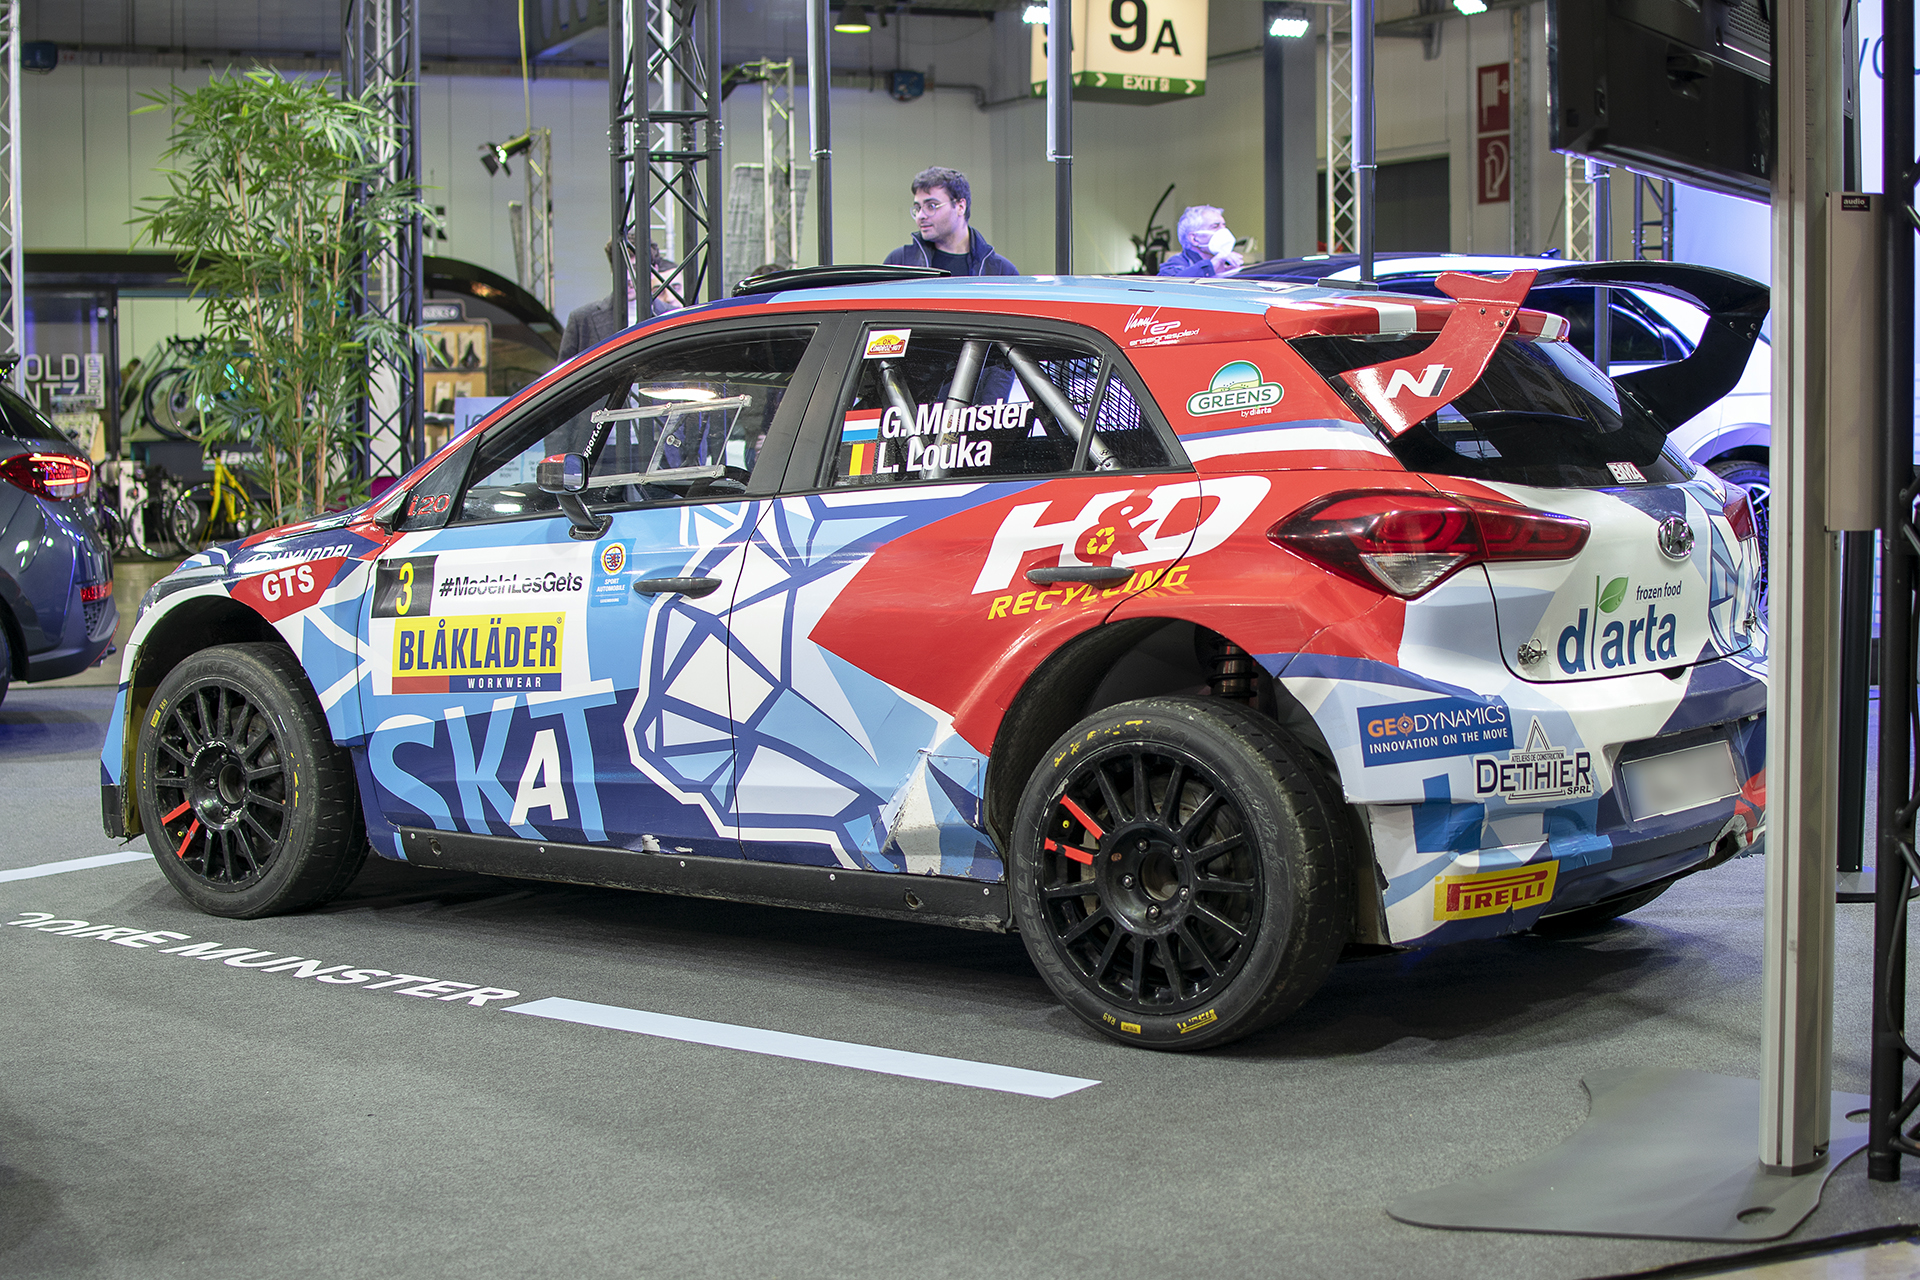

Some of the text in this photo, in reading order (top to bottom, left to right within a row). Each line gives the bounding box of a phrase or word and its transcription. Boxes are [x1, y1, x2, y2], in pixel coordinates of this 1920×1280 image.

[1122, 75, 1158, 92] EXIT
[881, 398, 1034, 439] G. Munster
[1198, 388, 1271, 410] GREENS
[876, 441, 899, 474] L.
[906, 435, 993, 473] Louka
[1607, 462, 1645, 480] BMA
[406, 493, 451, 517] i20
[971, 475, 1272, 595] H&D
[261, 564, 316, 603] GTS
[394, 561, 415, 616] 3
[1635, 580, 1682, 601] frozen food
[398, 618, 558, 671] BLÅKLÄDER
[467, 676, 543, 690] WORKWEAR
[368, 678, 618, 843] SKAT
[1369, 727, 1509, 755] INNOVATION ON THE MOVE
[1511, 754, 1531, 763] ATELIERS
[1537, 752, 1565, 761] CONSTRUCTION
[1476, 752, 1592, 795] DETHIER
[1566, 785, 1592, 795] SPRL
[1446, 869, 1549, 912] PIRELLI
[157, 941, 521, 1007] MUNSTER
